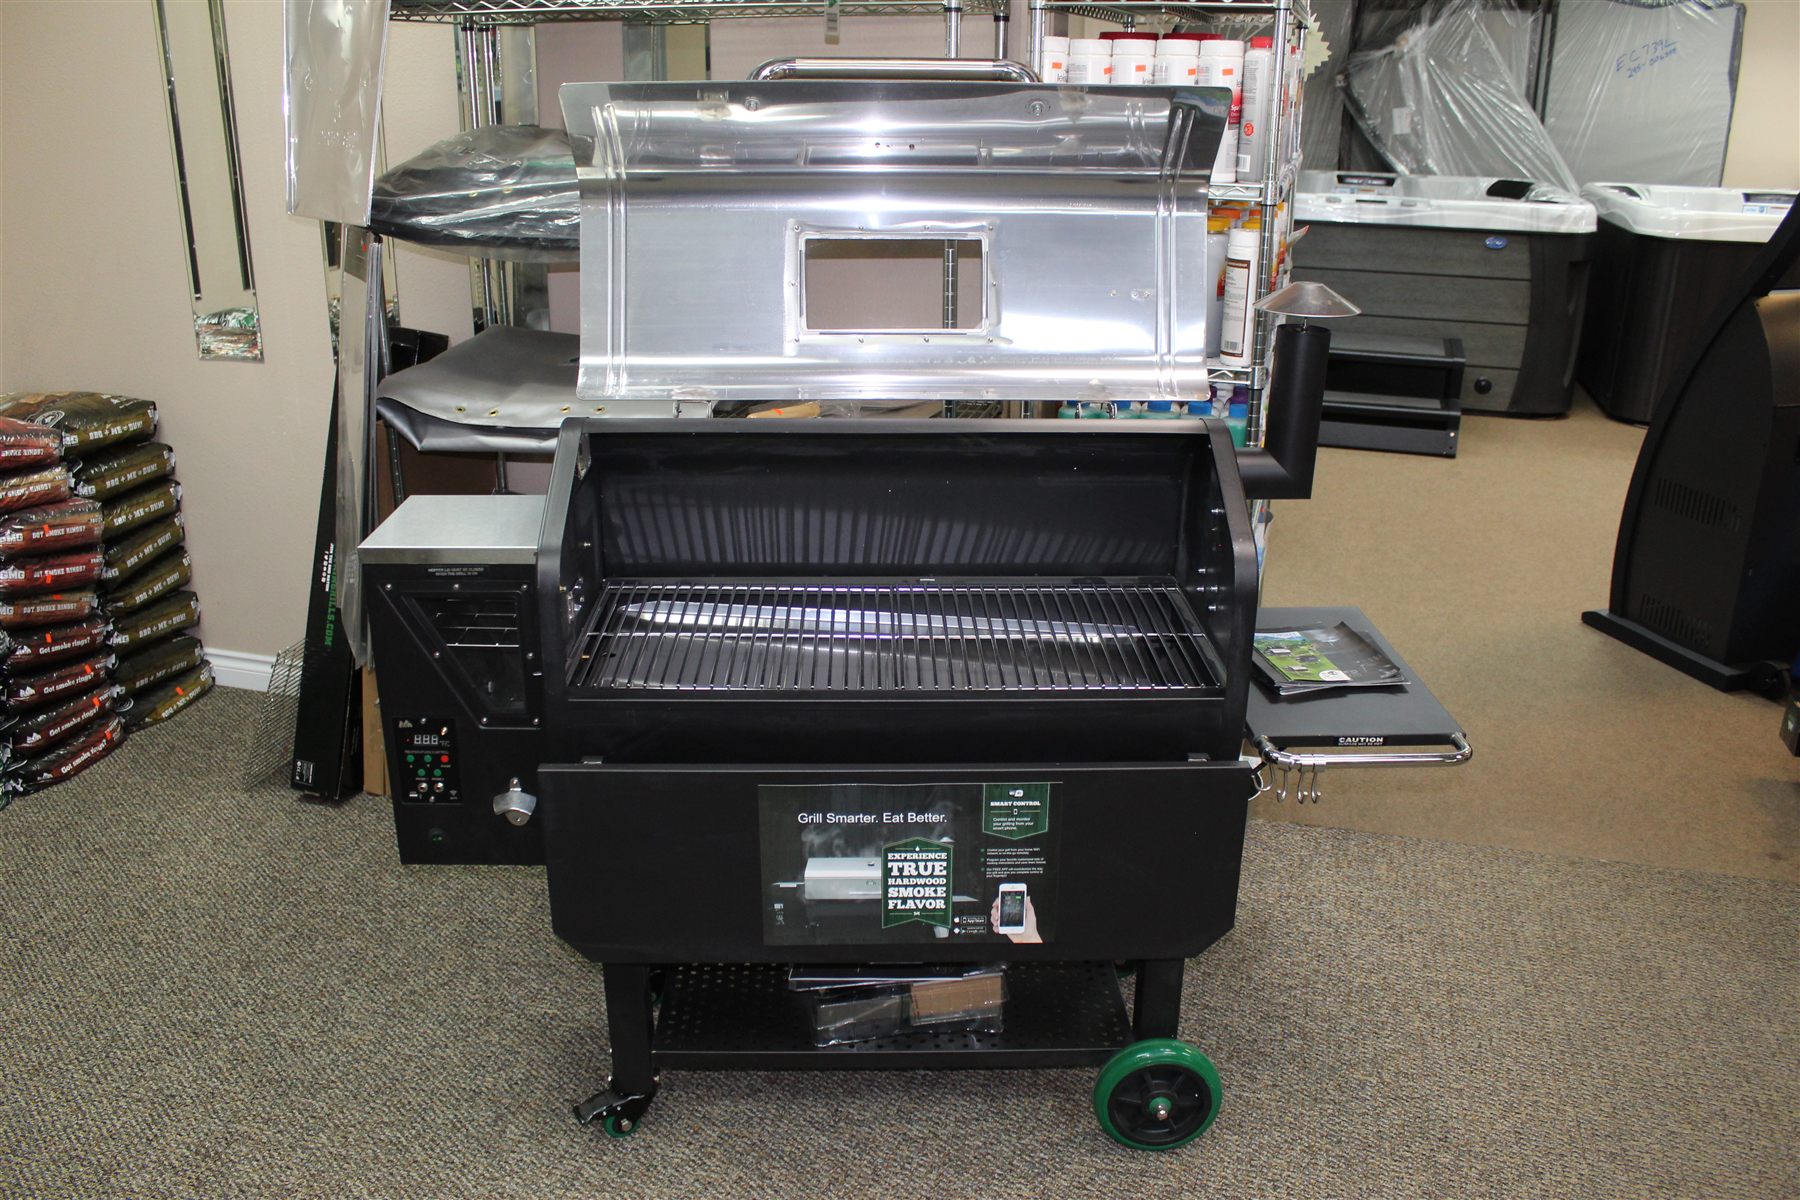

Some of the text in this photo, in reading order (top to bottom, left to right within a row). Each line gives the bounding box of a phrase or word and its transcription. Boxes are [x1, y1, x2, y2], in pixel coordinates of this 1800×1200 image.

[76, 482, 96, 496] MG
[0, 606, 14, 615] MG
[39, 636, 91, 655] Got smoke rings?
[43, 671, 95, 695] Got smoke rings?
[49, 705, 99, 737] Got smoke rings?
[61, 739, 107, 774] Got smoke rings?
[797, 812, 948, 824] Grill Smarter. Eat Better.
[888, 861, 947, 876] TRUE
[888, 877, 947, 885] HARDWOOD
[888, 887, 946, 898] SMOKE
[888, 899, 946, 910] FLAVOR
